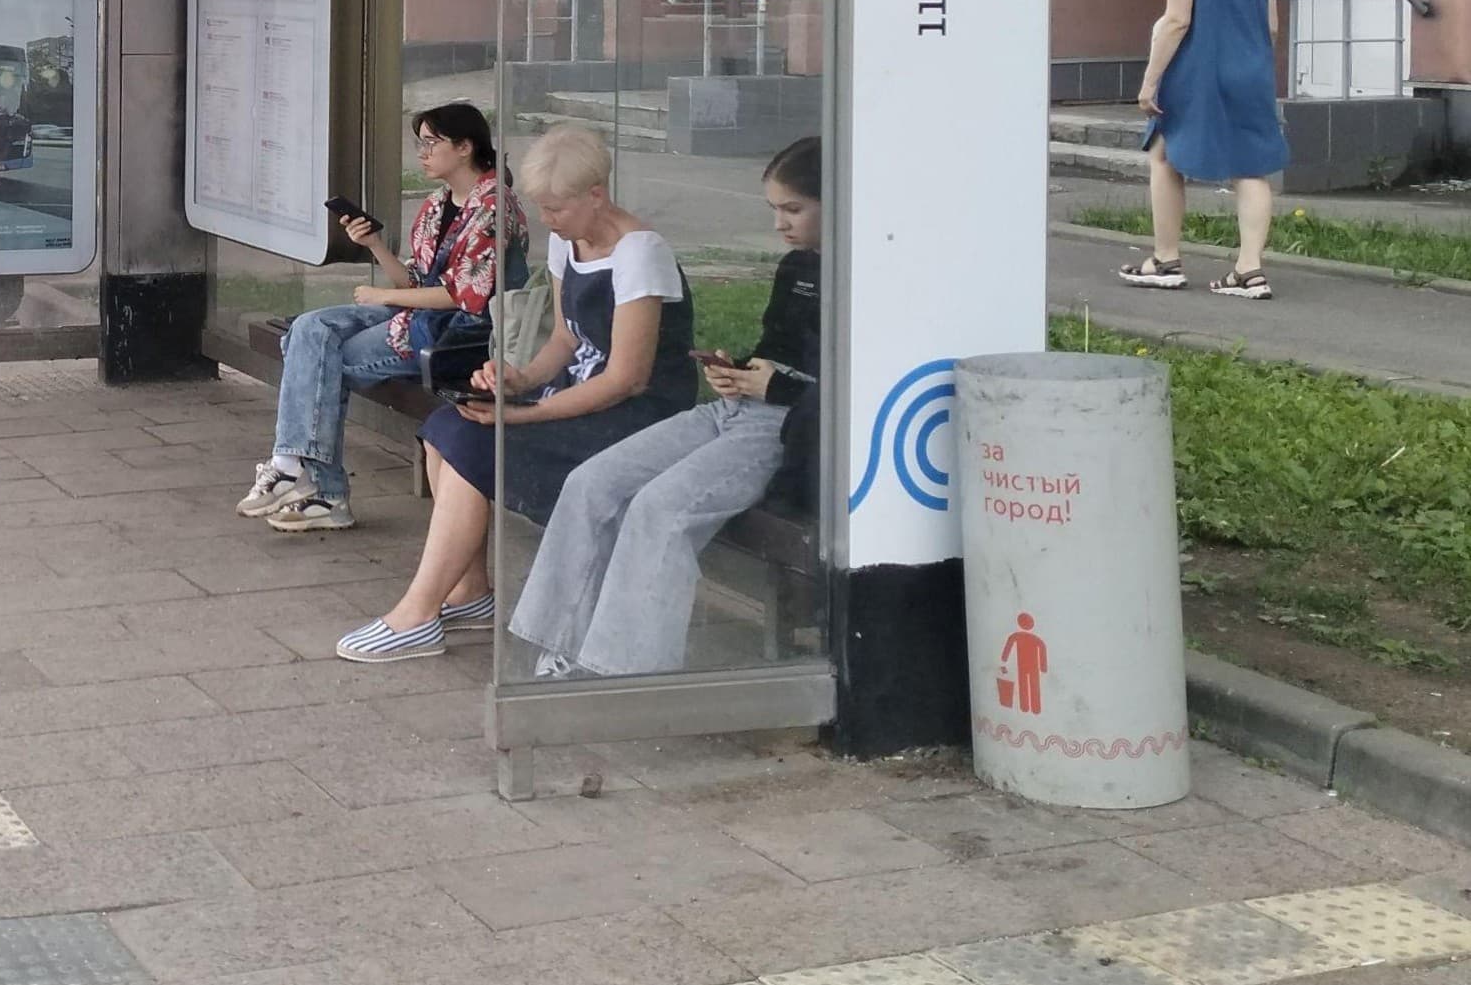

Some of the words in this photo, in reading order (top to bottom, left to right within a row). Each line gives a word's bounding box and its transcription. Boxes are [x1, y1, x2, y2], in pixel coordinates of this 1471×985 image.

[981, 442, 1004, 462] за
[983, 470, 1081, 495] чистый
[985, 497, 1071, 525] город!
